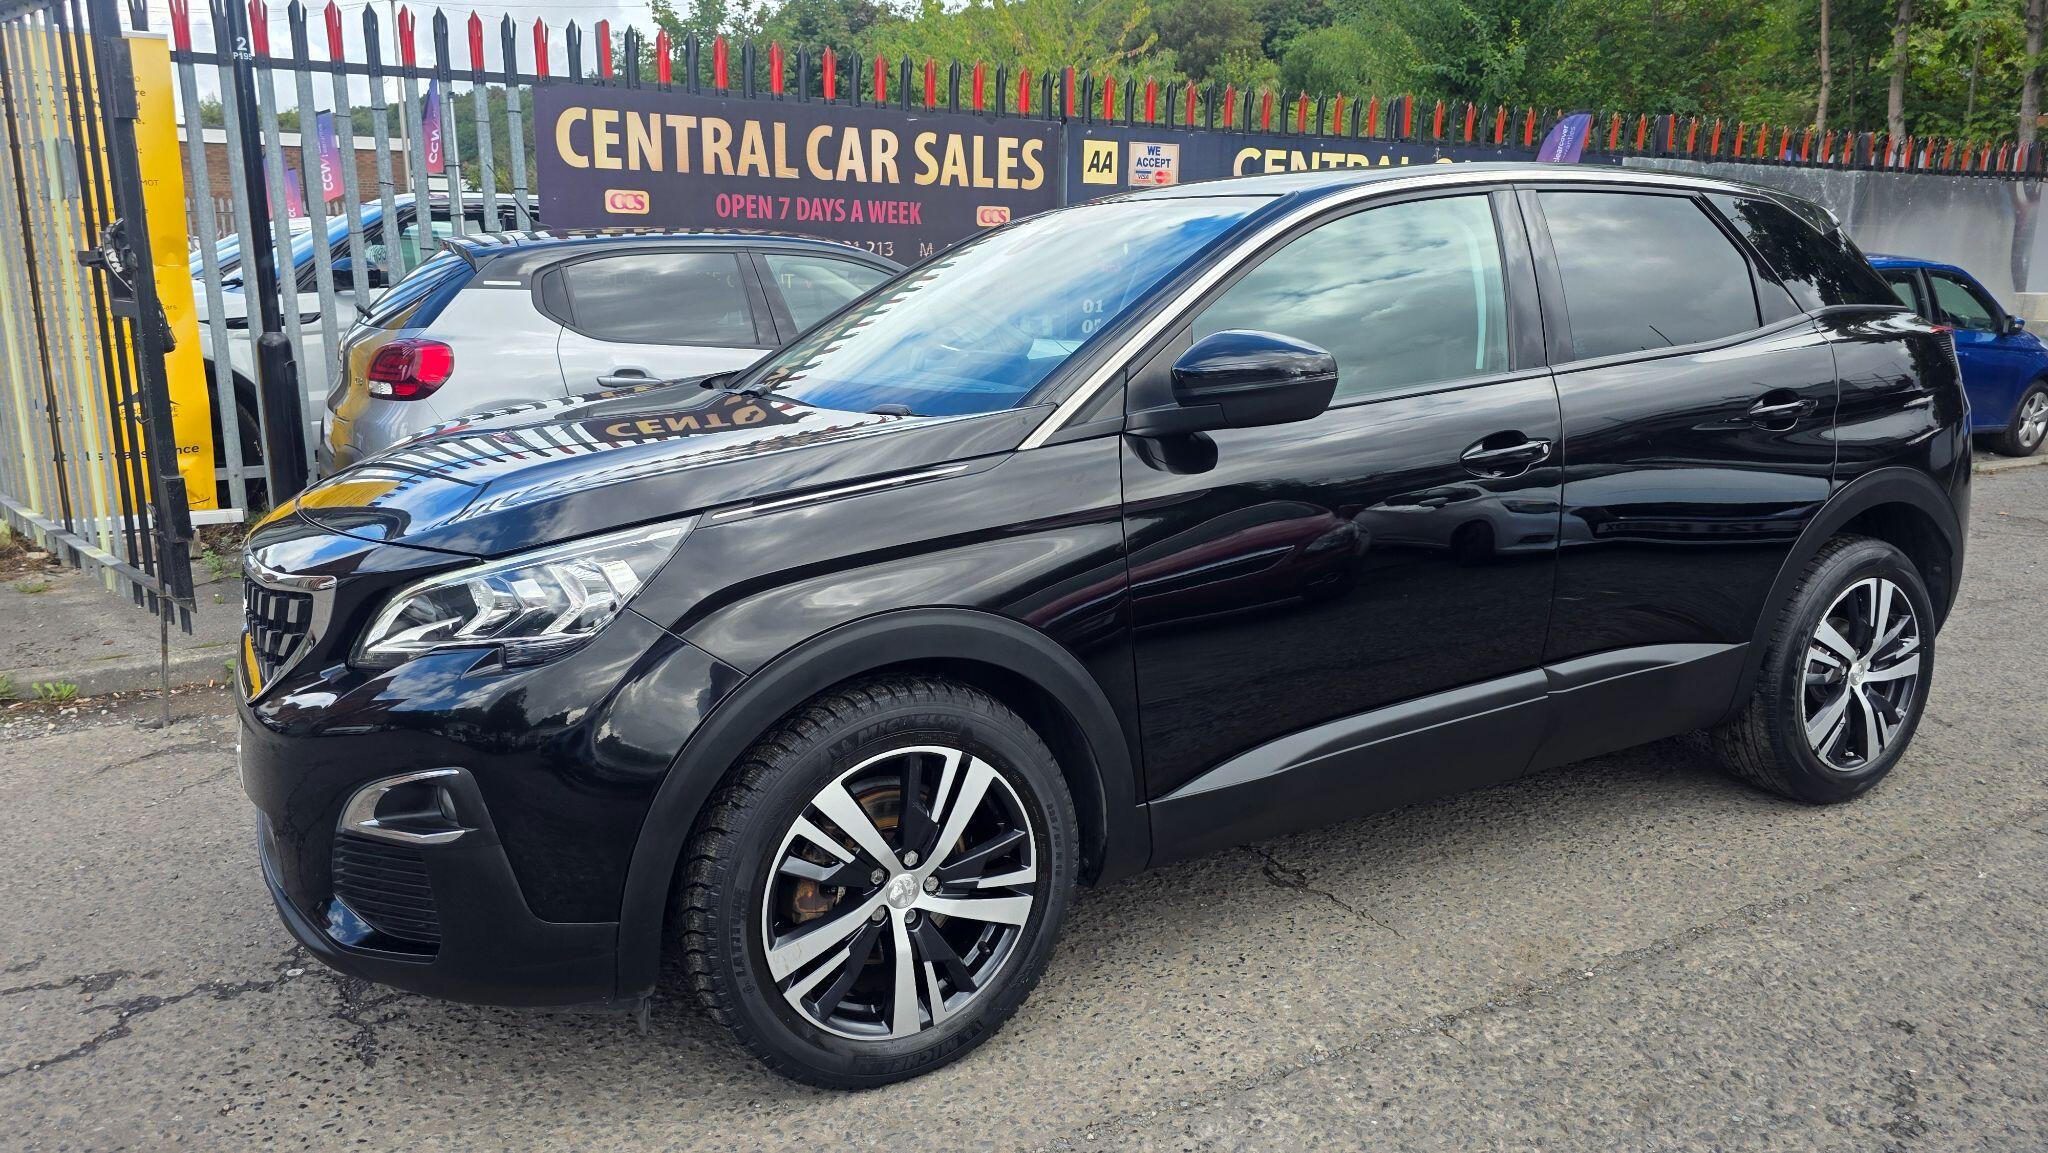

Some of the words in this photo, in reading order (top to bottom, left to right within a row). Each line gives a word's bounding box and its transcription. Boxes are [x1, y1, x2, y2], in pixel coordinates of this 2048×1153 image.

[236, 36, 248, 51] 2
[430, 119, 441, 164] CCW
[555, 106, 800, 179] CENTRAL
[806, 124, 901, 185] CAR
[914, 131, 1045, 191] SALES
[1147, 145, 1161, 156] WE
[320, 157, 334, 191] CCW
[1087, 150, 1113, 173] AA
[1136, 157, 1171, 168] ACCEPT
[715, 193, 773, 220] OPEN
[778, 197, 790, 220] 7
[796, 197, 846, 222] DAYS
[850, 200, 864, 223] A
[867, 200, 922, 225] WEEK
